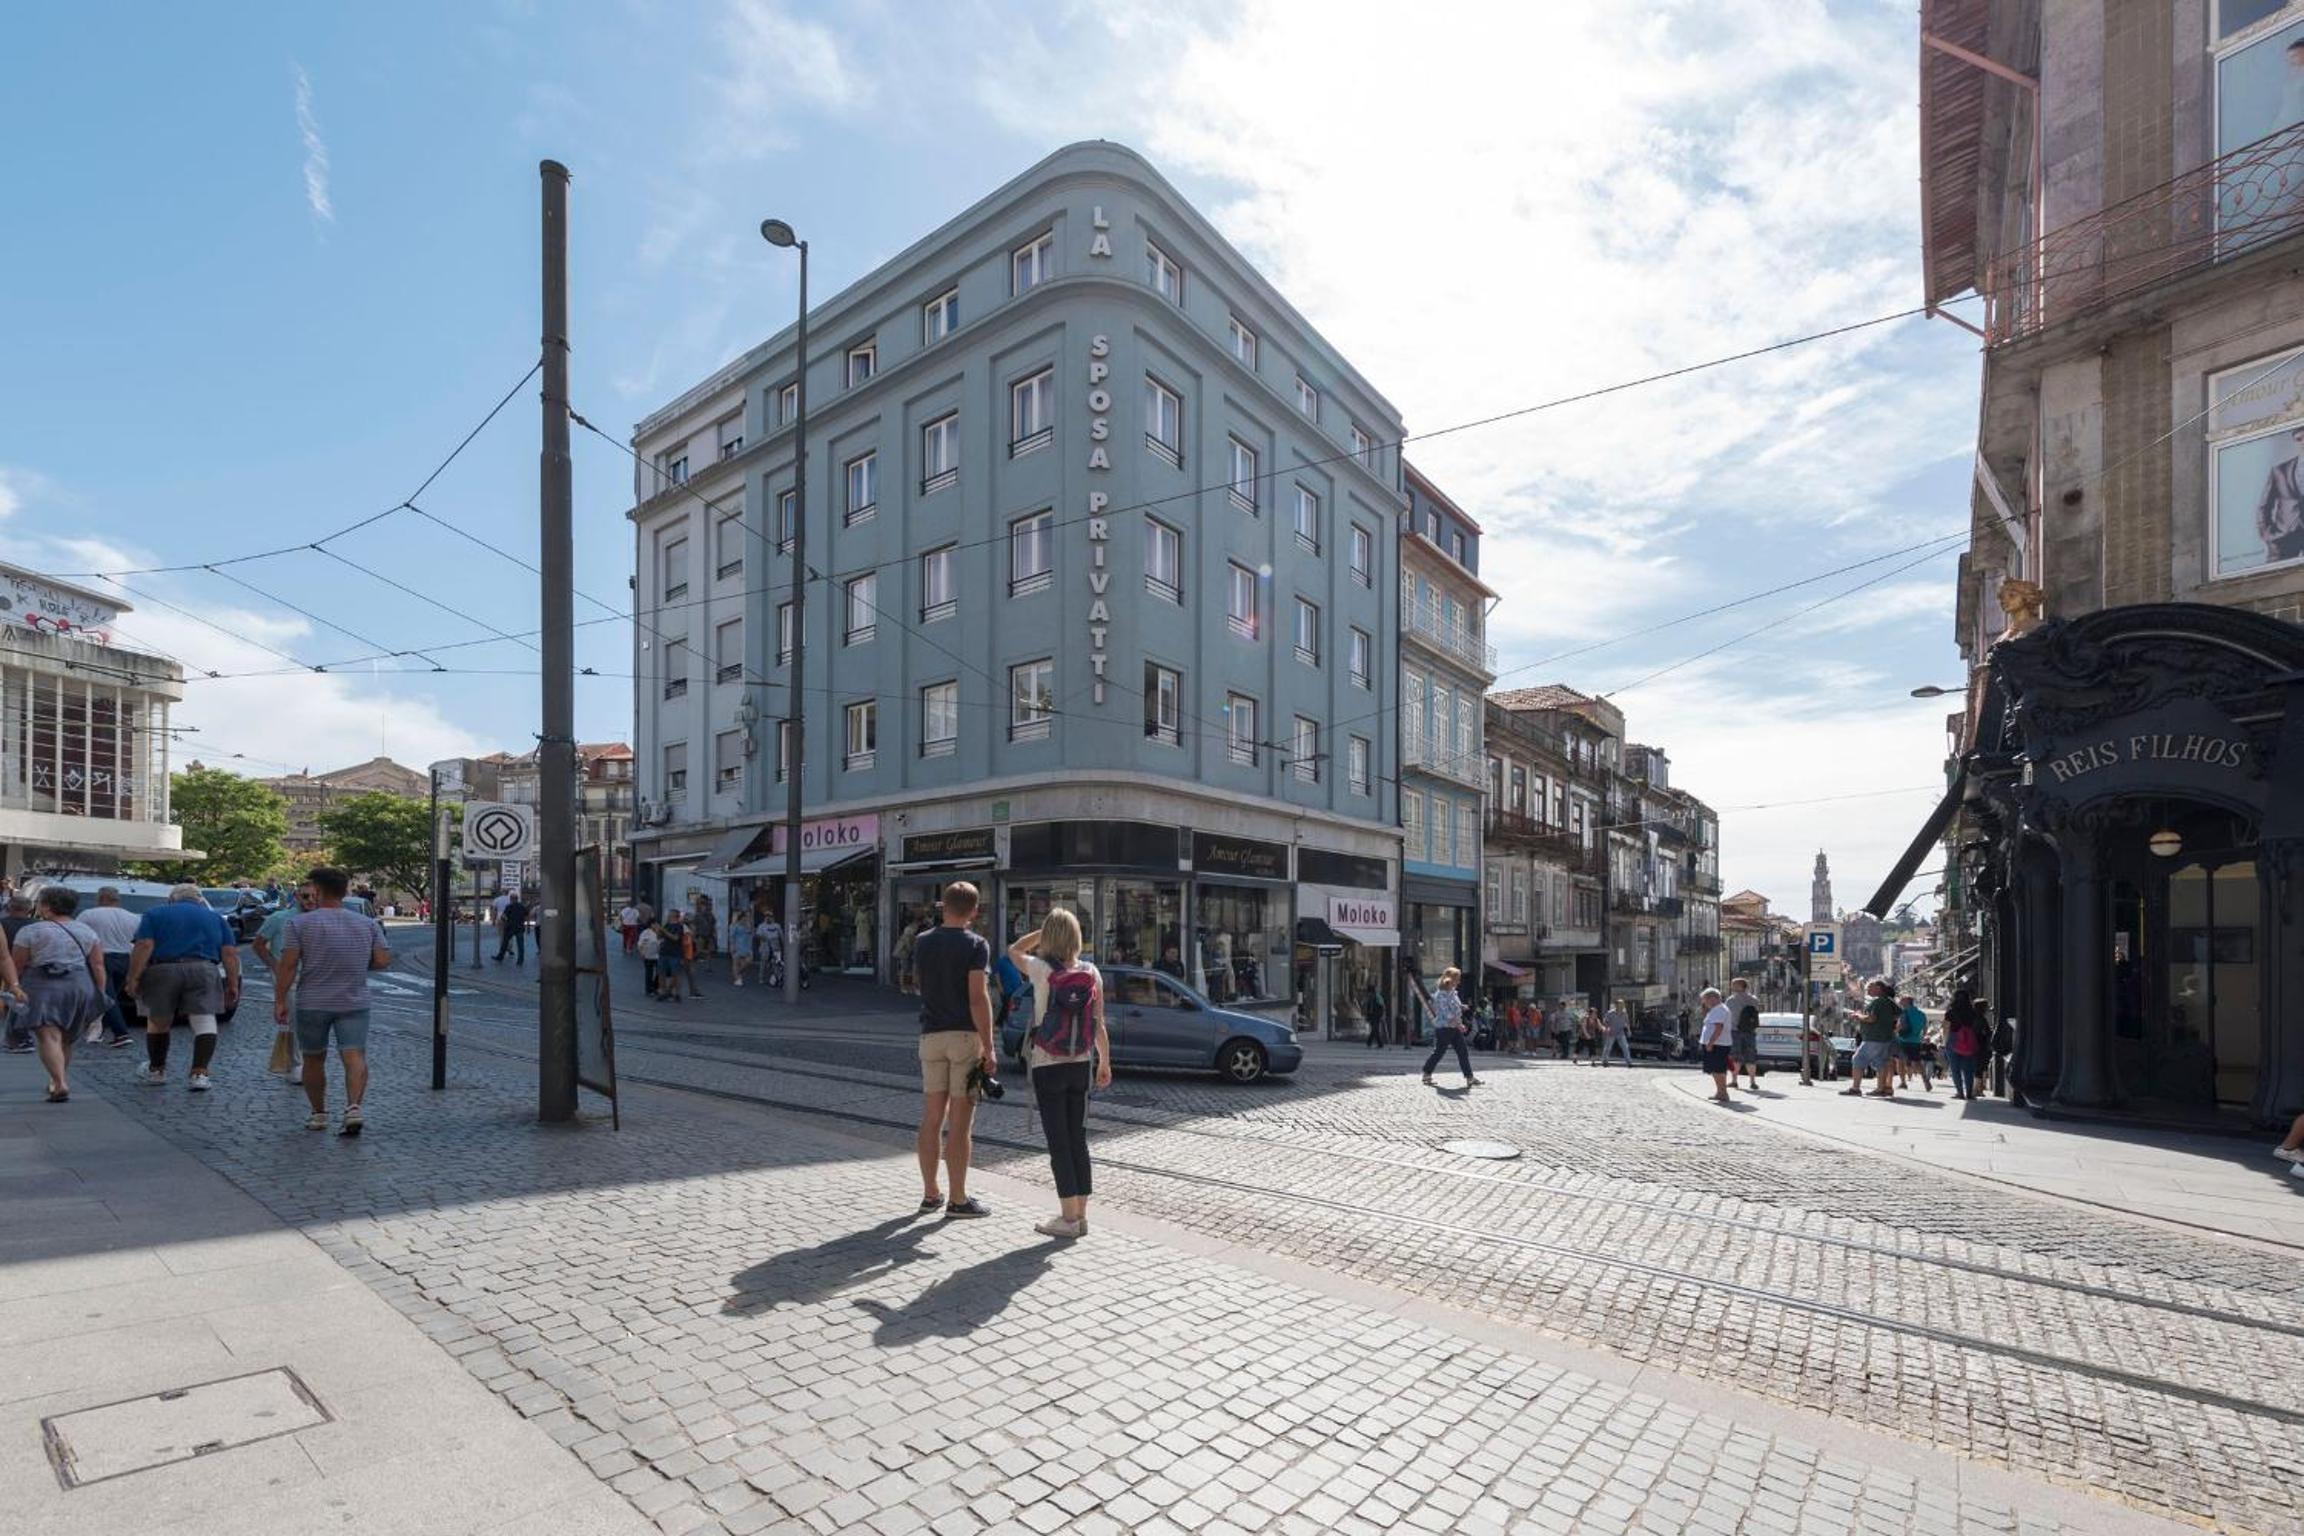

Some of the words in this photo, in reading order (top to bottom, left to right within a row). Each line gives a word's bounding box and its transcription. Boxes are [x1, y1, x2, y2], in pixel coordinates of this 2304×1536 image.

[1092, 206, 1112, 257] LA
[1089, 335, 1111, 470] SPOSA
[1089, 491, 1110, 704] PRIVATTI
[2051, 740, 2119, 783] REIS
[2131, 734, 2248, 768] FILHOS
[803, 822, 860, 848] oloko
[1337, 903, 1387, 924] Moloko
[1814, 934, 1829, 951] P
